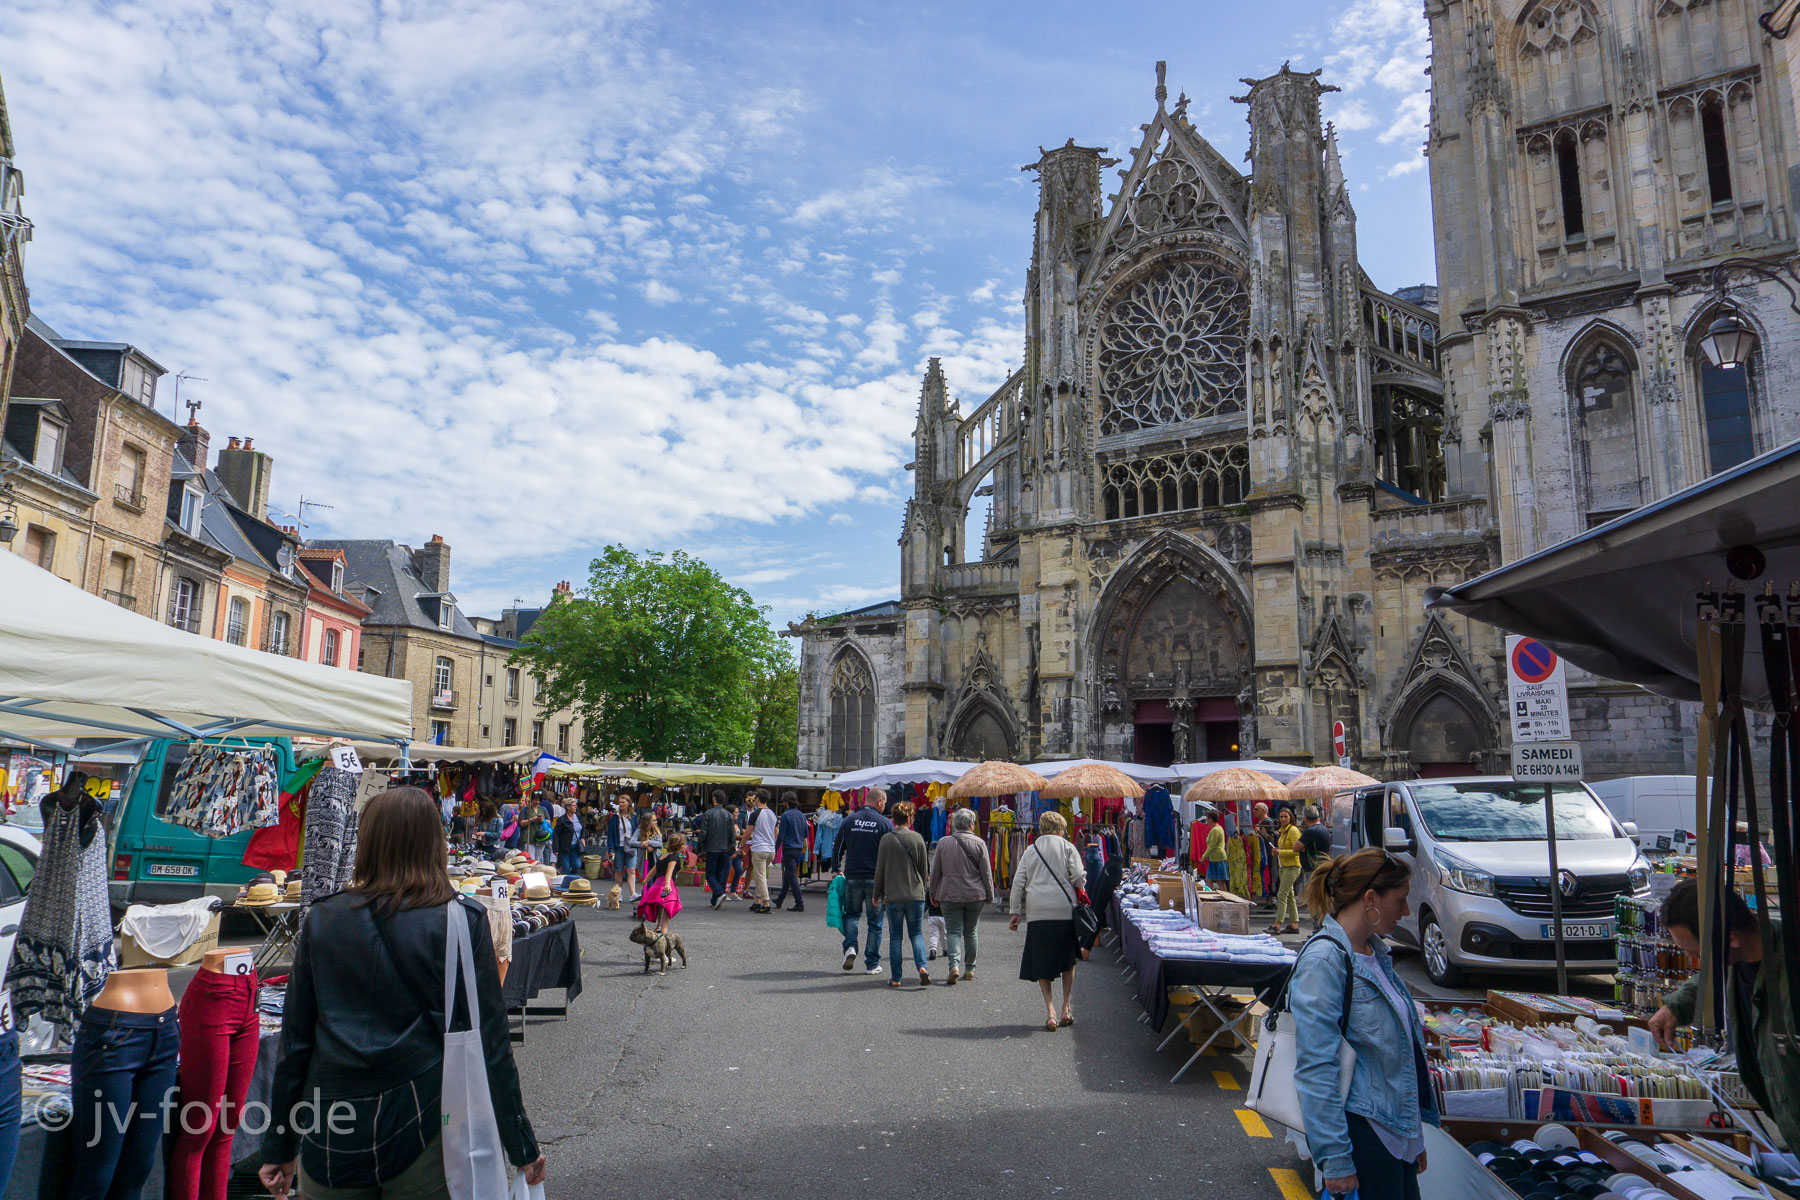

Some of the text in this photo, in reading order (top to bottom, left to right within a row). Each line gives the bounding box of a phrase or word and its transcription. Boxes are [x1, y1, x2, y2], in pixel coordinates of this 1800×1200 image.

[1516, 689, 1555, 698] LIVRAISONS
[1530, 709, 1560, 717] MINUTES
[1521, 748, 1573, 760] SAMEDI
[340, 751, 358, 769] 5€
[1516, 764, 1580, 775] DE 6H30 A 14H
[854, 819, 877, 828] tyco
[1549, 926, 1602, 937] D-021-DJ
